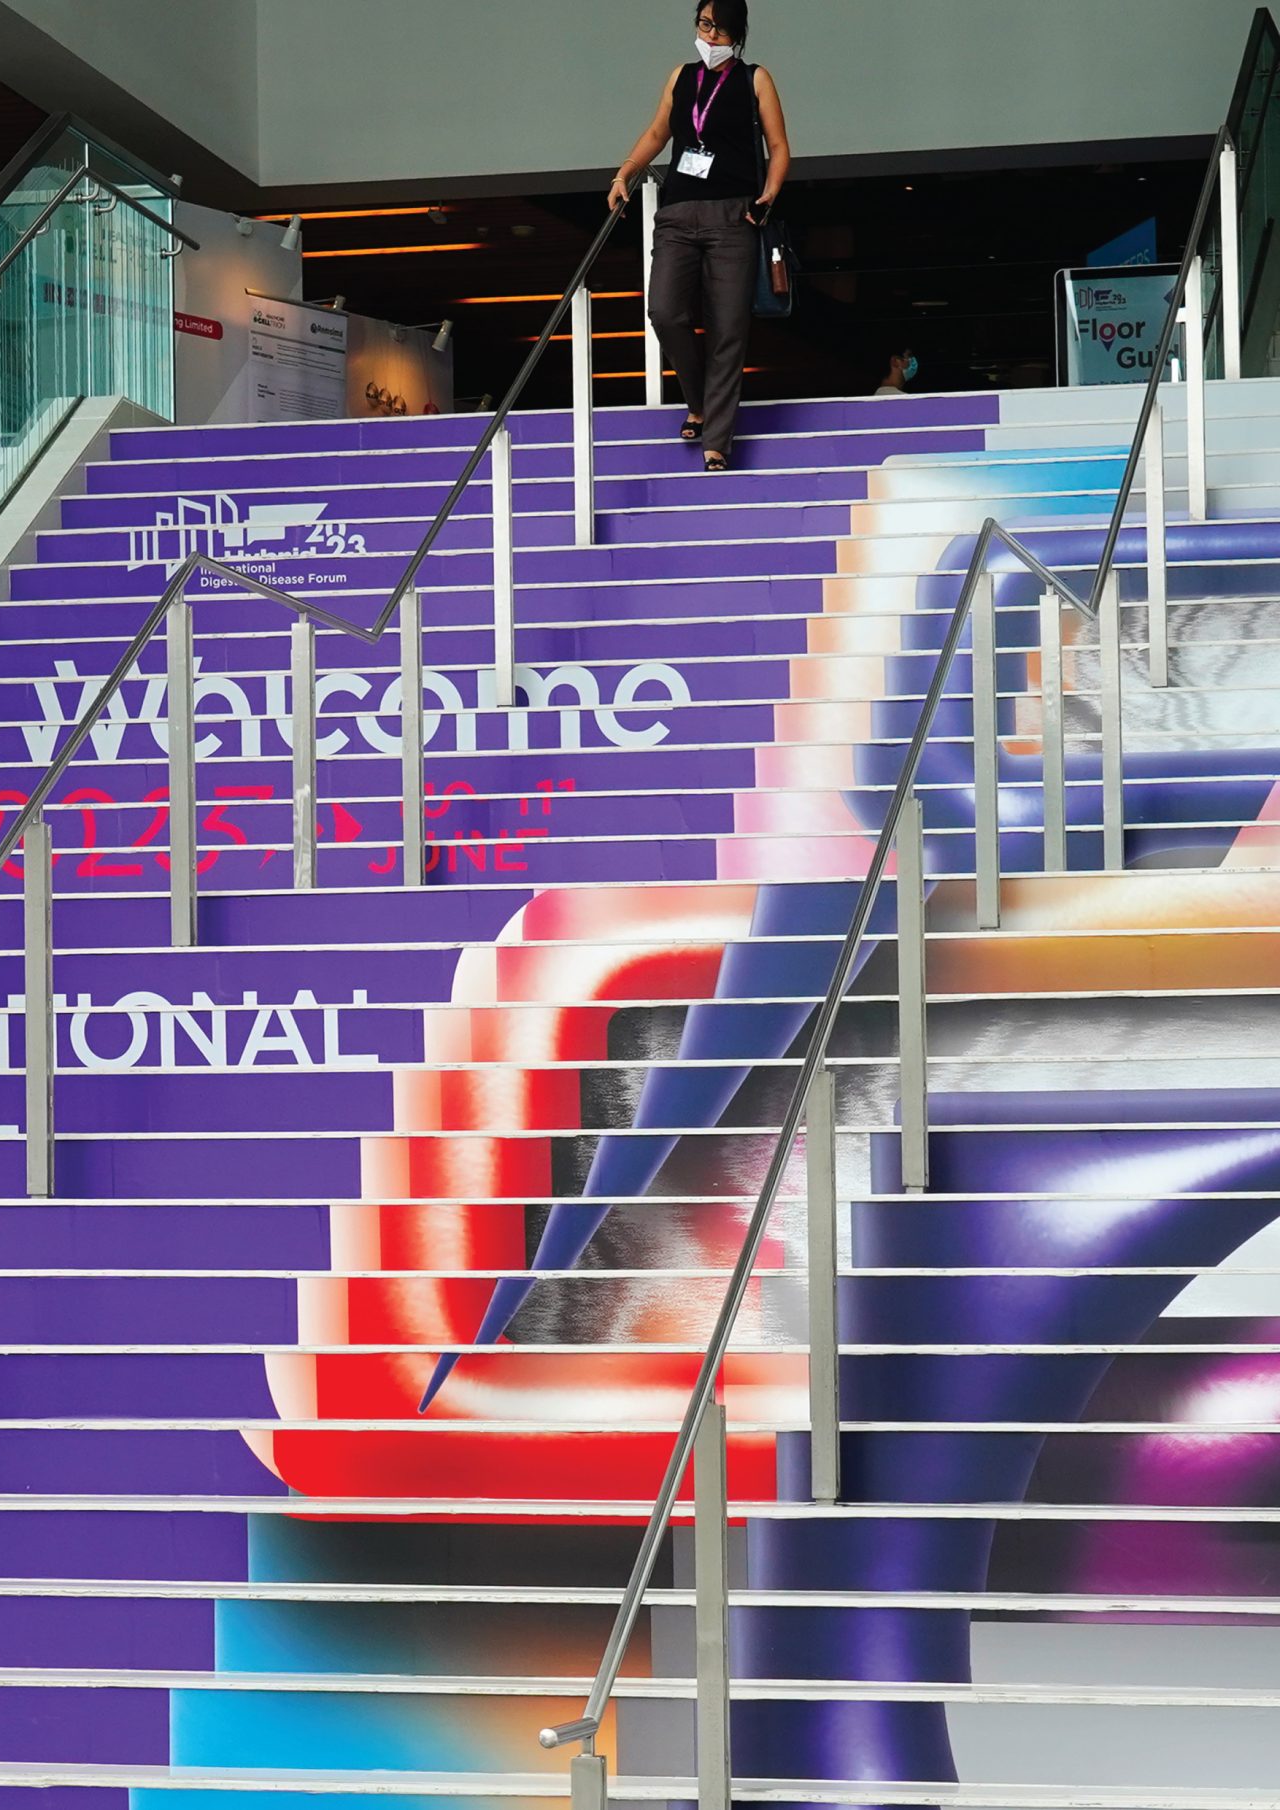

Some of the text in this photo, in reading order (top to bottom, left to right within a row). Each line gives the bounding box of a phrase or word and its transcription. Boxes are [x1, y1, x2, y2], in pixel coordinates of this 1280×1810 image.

[184, 318, 213, 333] Limited
[1074, 318, 1146, 341] Floor
[259, 574, 305, 586] Disease
[308, 573, 347, 584] Forum
[20, 656, 692, 763] Welcome
